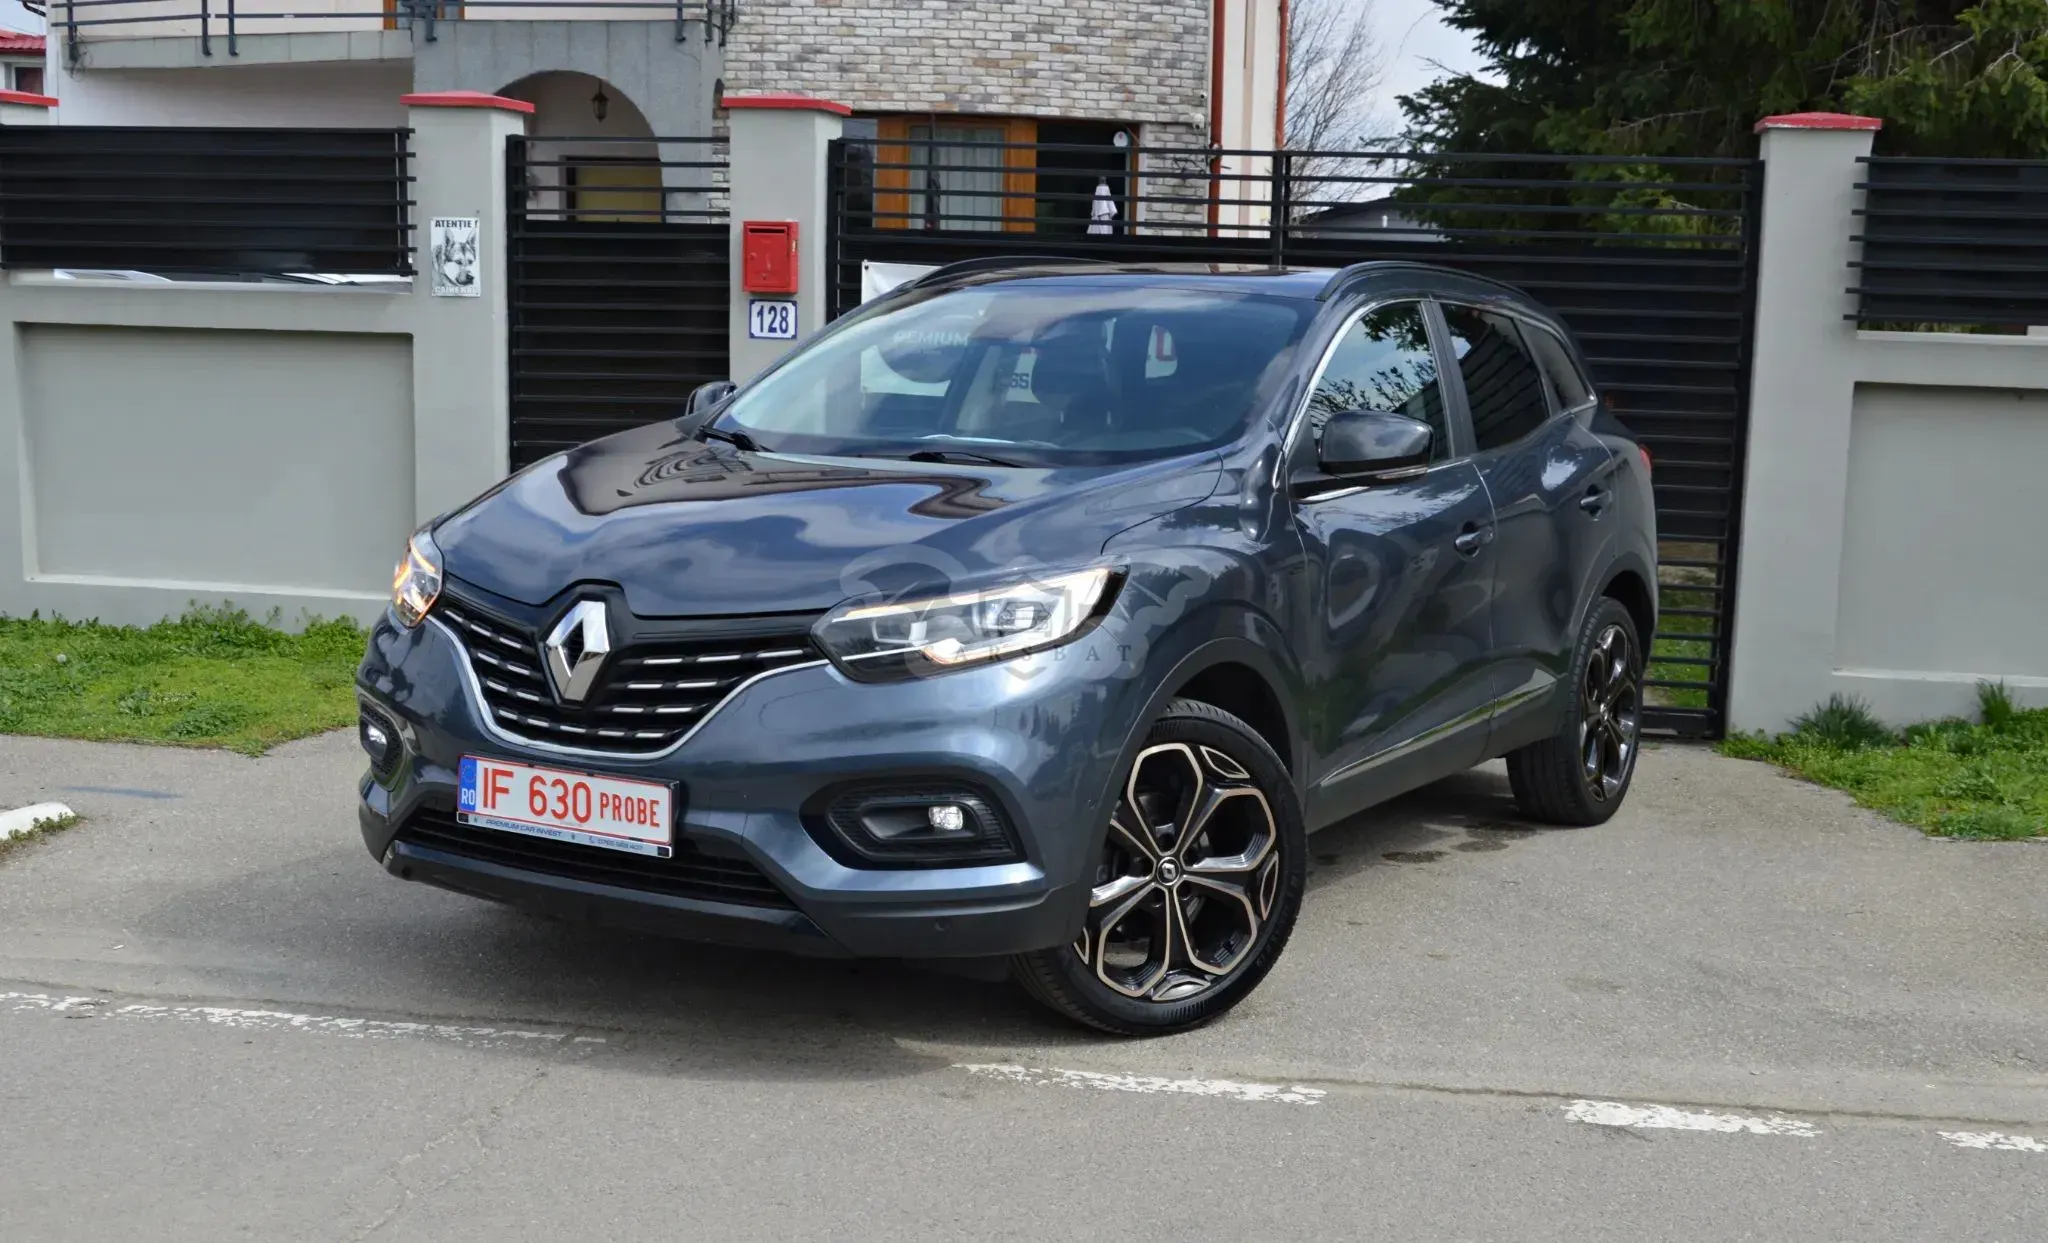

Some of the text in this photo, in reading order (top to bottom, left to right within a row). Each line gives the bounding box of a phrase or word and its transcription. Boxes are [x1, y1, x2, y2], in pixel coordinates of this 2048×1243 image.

[757, 305, 789, 334] 128
[461, 787, 475, 806] RO
[483, 767, 660, 828] IF 630 PROBE
[485, 819, 562, 837] PREMIUM CAR INVEST
